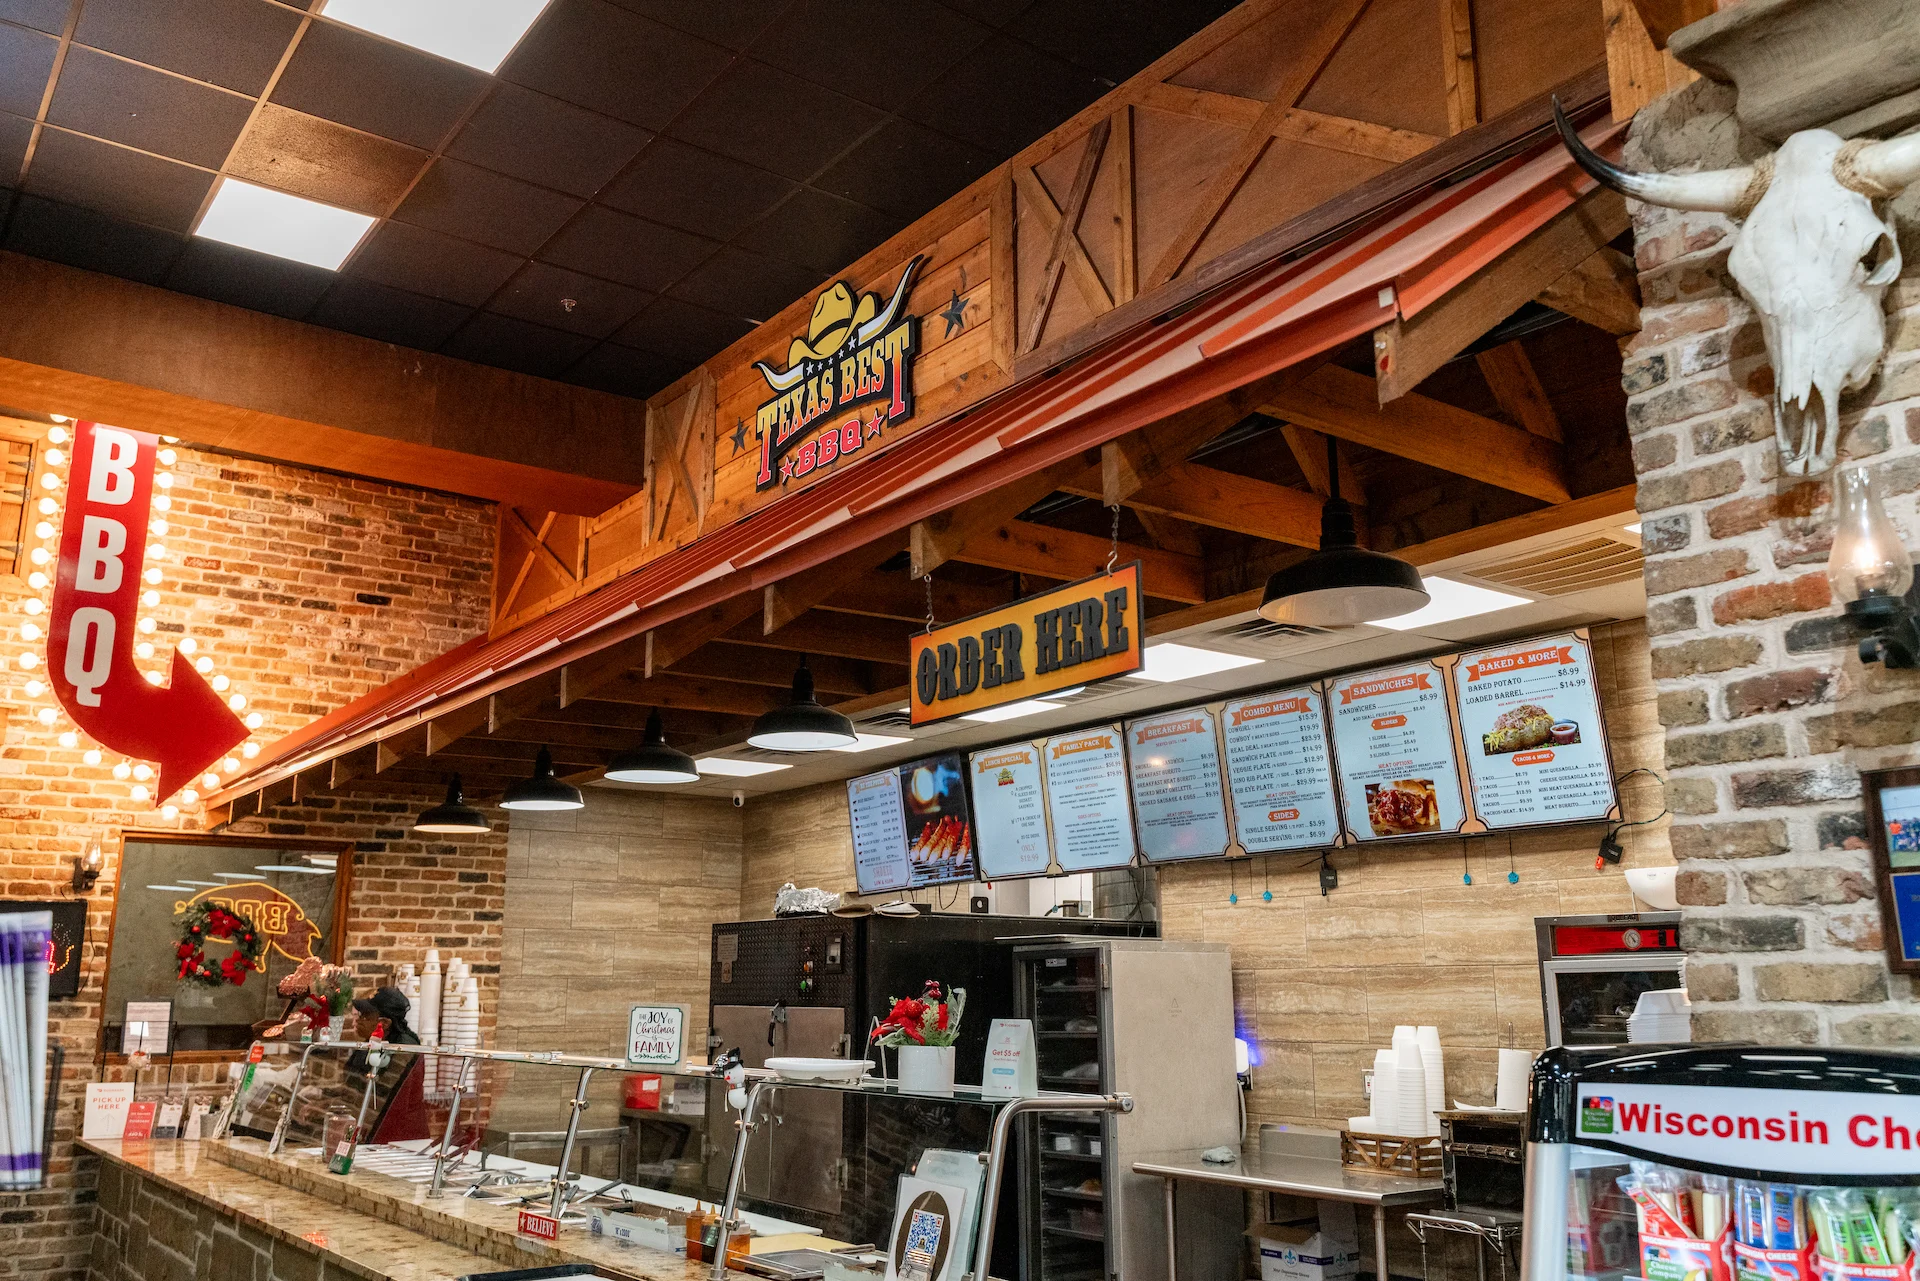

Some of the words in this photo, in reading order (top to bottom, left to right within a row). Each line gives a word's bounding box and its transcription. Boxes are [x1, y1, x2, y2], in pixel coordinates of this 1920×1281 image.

[757, 367, 834, 485] TEXAS
[839, 322, 910, 420] BEST
[796, 420, 862, 477] BBQ
[64, 428, 139, 707] BBQ
[916, 623, 1024, 705] ORDER
[1034, 586, 1129, 674] HERE
[1478, 658, 1514, 671] BAKED
[1517, 656, 1524, 664] &
[1527, 649, 1556, 662] MORE
[1353, 676, 1413, 695] SANDWICHES
[1468, 682, 1491, 692] BAKED
[1493, 677, 1521, 687] POTATO
[1465, 694, 1492, 704] LOADED
[1494, 689, 1523, 699] BARREL
[1559, 678, 1585, 689] $14.99
[1243, 706, 1270, 717] COMBO
[1272, 701, 1295, 712] MENU
[1338, 703, 1376, 715] SANDWICHES
[1147, 722, 1190, 736] BREAKFAST
[1228, 724, 1250, 733] COWGIRL
[1062, 740, 1083, 751] FAMILY
[1083, 738, 1099, 747] PACK
[1229, 734, 1250, 743] COWBOY
[1001, 754, 1021, 763] SPECIAL
[1231, 753, 1258, 763] SANDWICH
[1233, 765, 1252, 773] VEGGIE
[1253, 762, 1270, 770] PLATE
[1135, 770, 1161, 779] BREAKFAST
[1558, 773, 1587, 781] QUESADILLA
[1136, 780, 1162, 788] BREAKFAST
[1176, 774, 1196, 782] BURRITO
[1273, 811, 1294, 819] SIDES
[1264, 823, 1287, 831] SERVING
[1268, 833, 1291, 841] SERVING
[648, 1012, 668, 1024] JOY
[636, 1022, 675, 1034] Christmas
[635, 1041, 674, 1053] FAMILY
[1618, 1102, 1828, 1145] Wisconsin
[1848, 1114, 1920, 1150] Ch
[526, 1216, 555, 1238] BELIEVE
[1650, 1261, 1676, 1271] Cheese
[1648, 1268, 1682, 1280] Company
